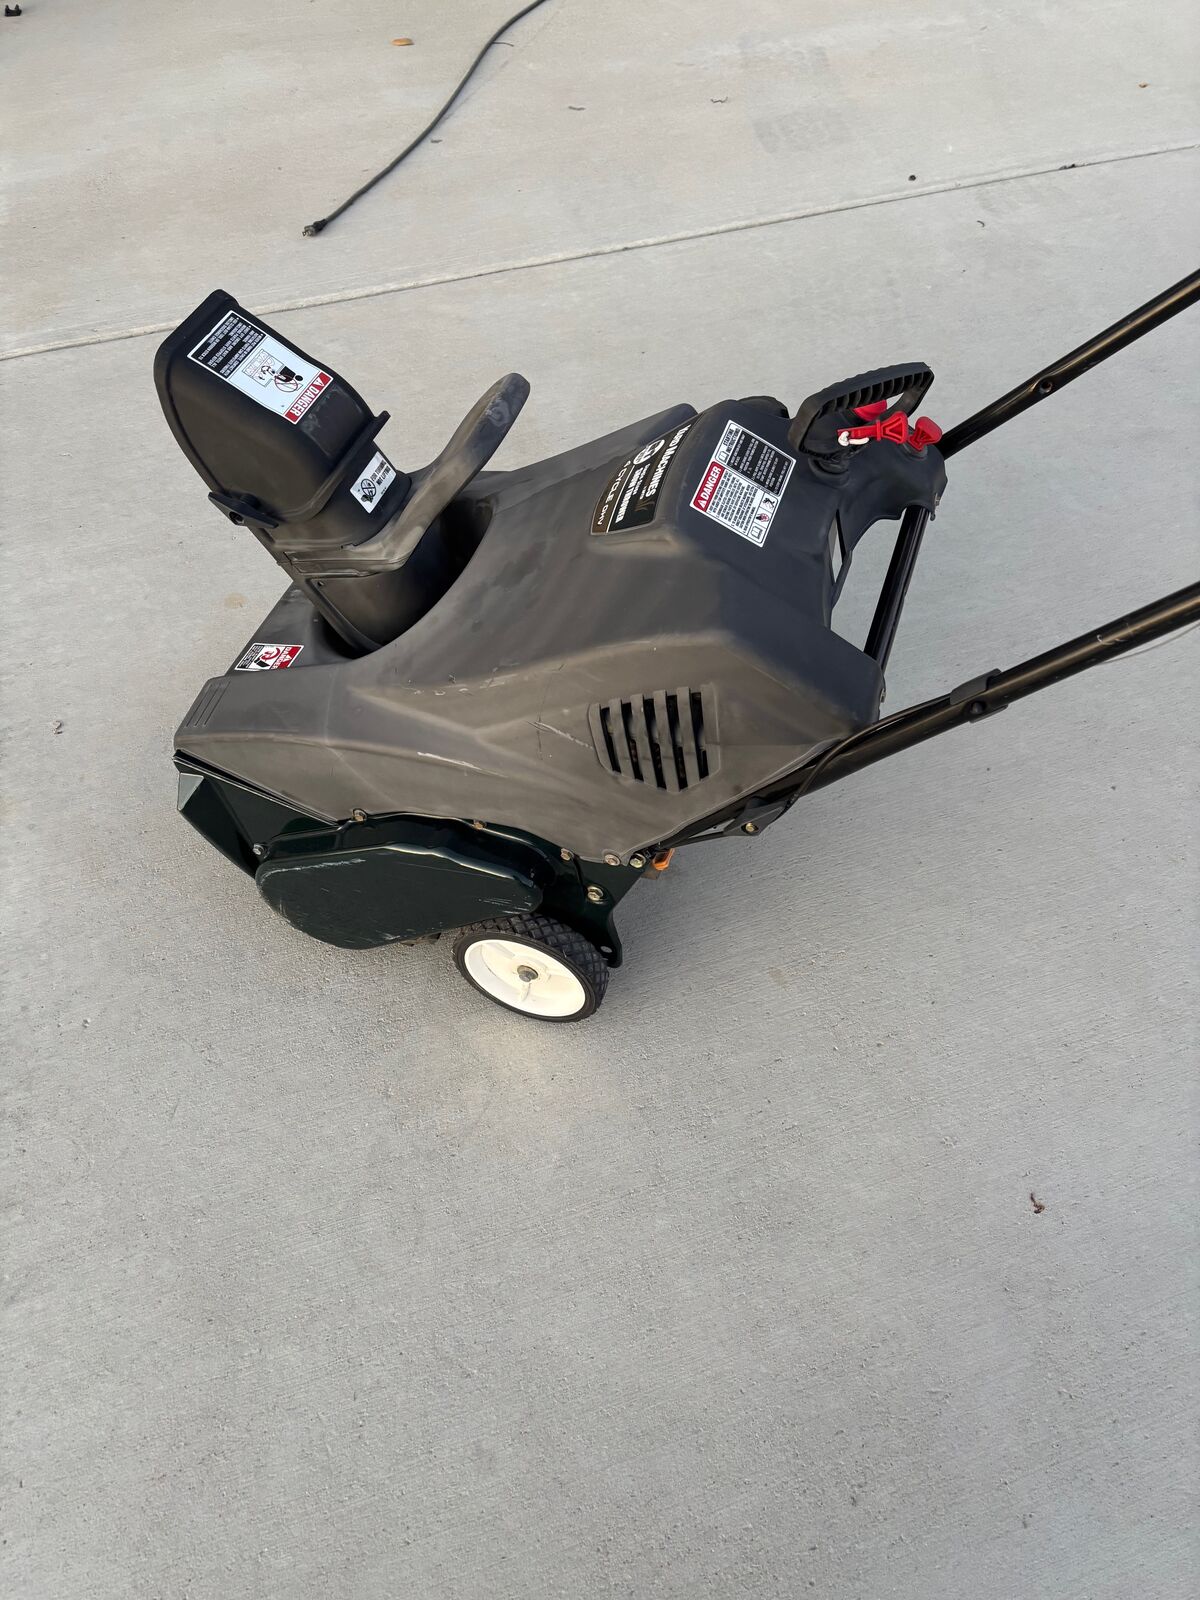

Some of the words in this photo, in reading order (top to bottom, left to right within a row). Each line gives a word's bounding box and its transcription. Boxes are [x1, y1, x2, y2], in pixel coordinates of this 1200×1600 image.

[290, 386, 319, 417] DANGER
[606, 467, 628, 504] CYCLE
[646, 445, 678, 497] MACHINES
[701, 466, 721, 500] DANGER
[597, 504, 608, 525] OHV
